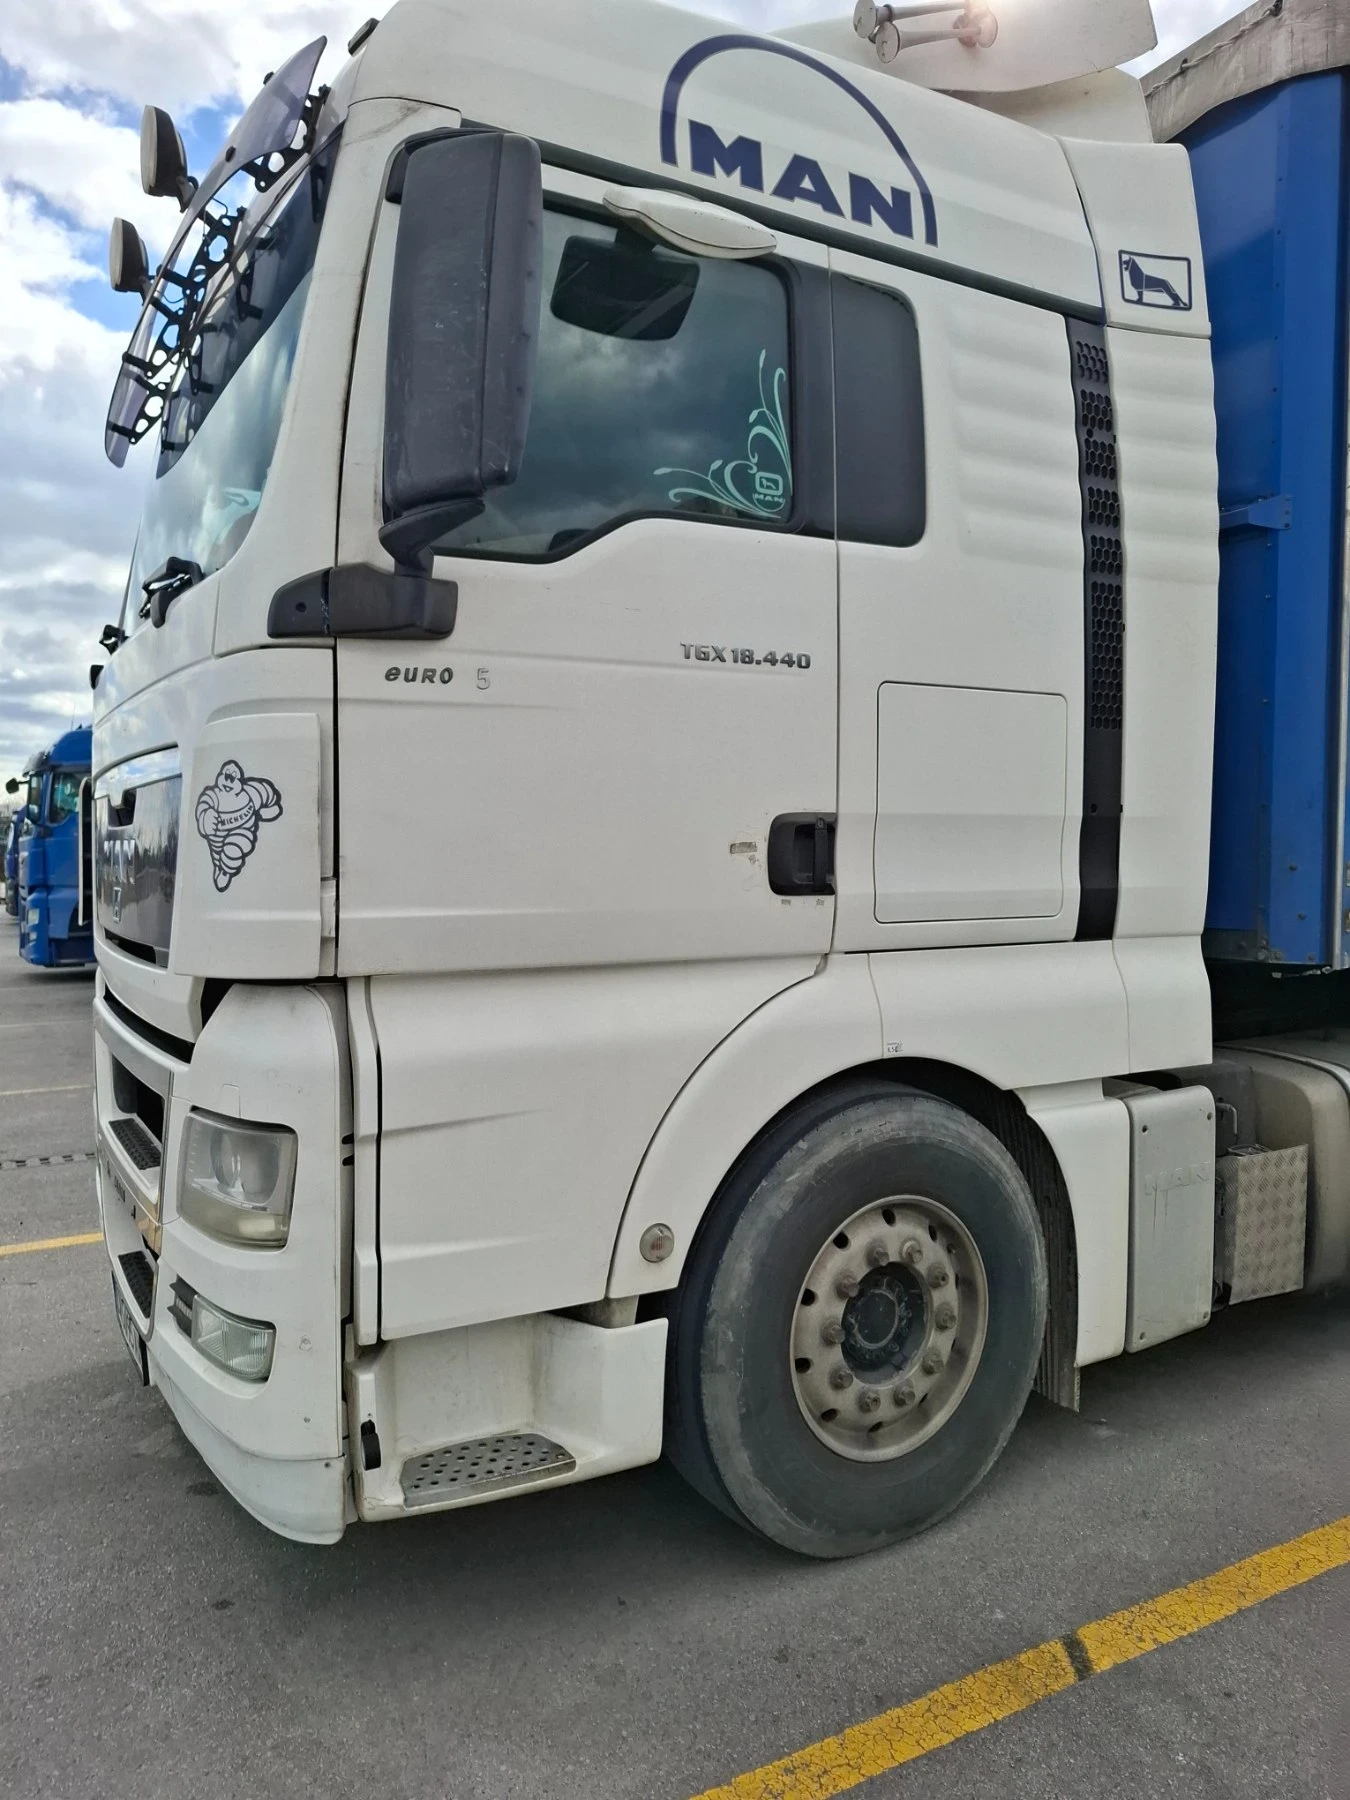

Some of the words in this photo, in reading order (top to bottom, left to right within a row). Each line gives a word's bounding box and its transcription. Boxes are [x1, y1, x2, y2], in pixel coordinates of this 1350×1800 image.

[688, 118, 914, 240] MAN
[754, 493, 784, 503] MAN
[476, 667, 491, 690] 5
